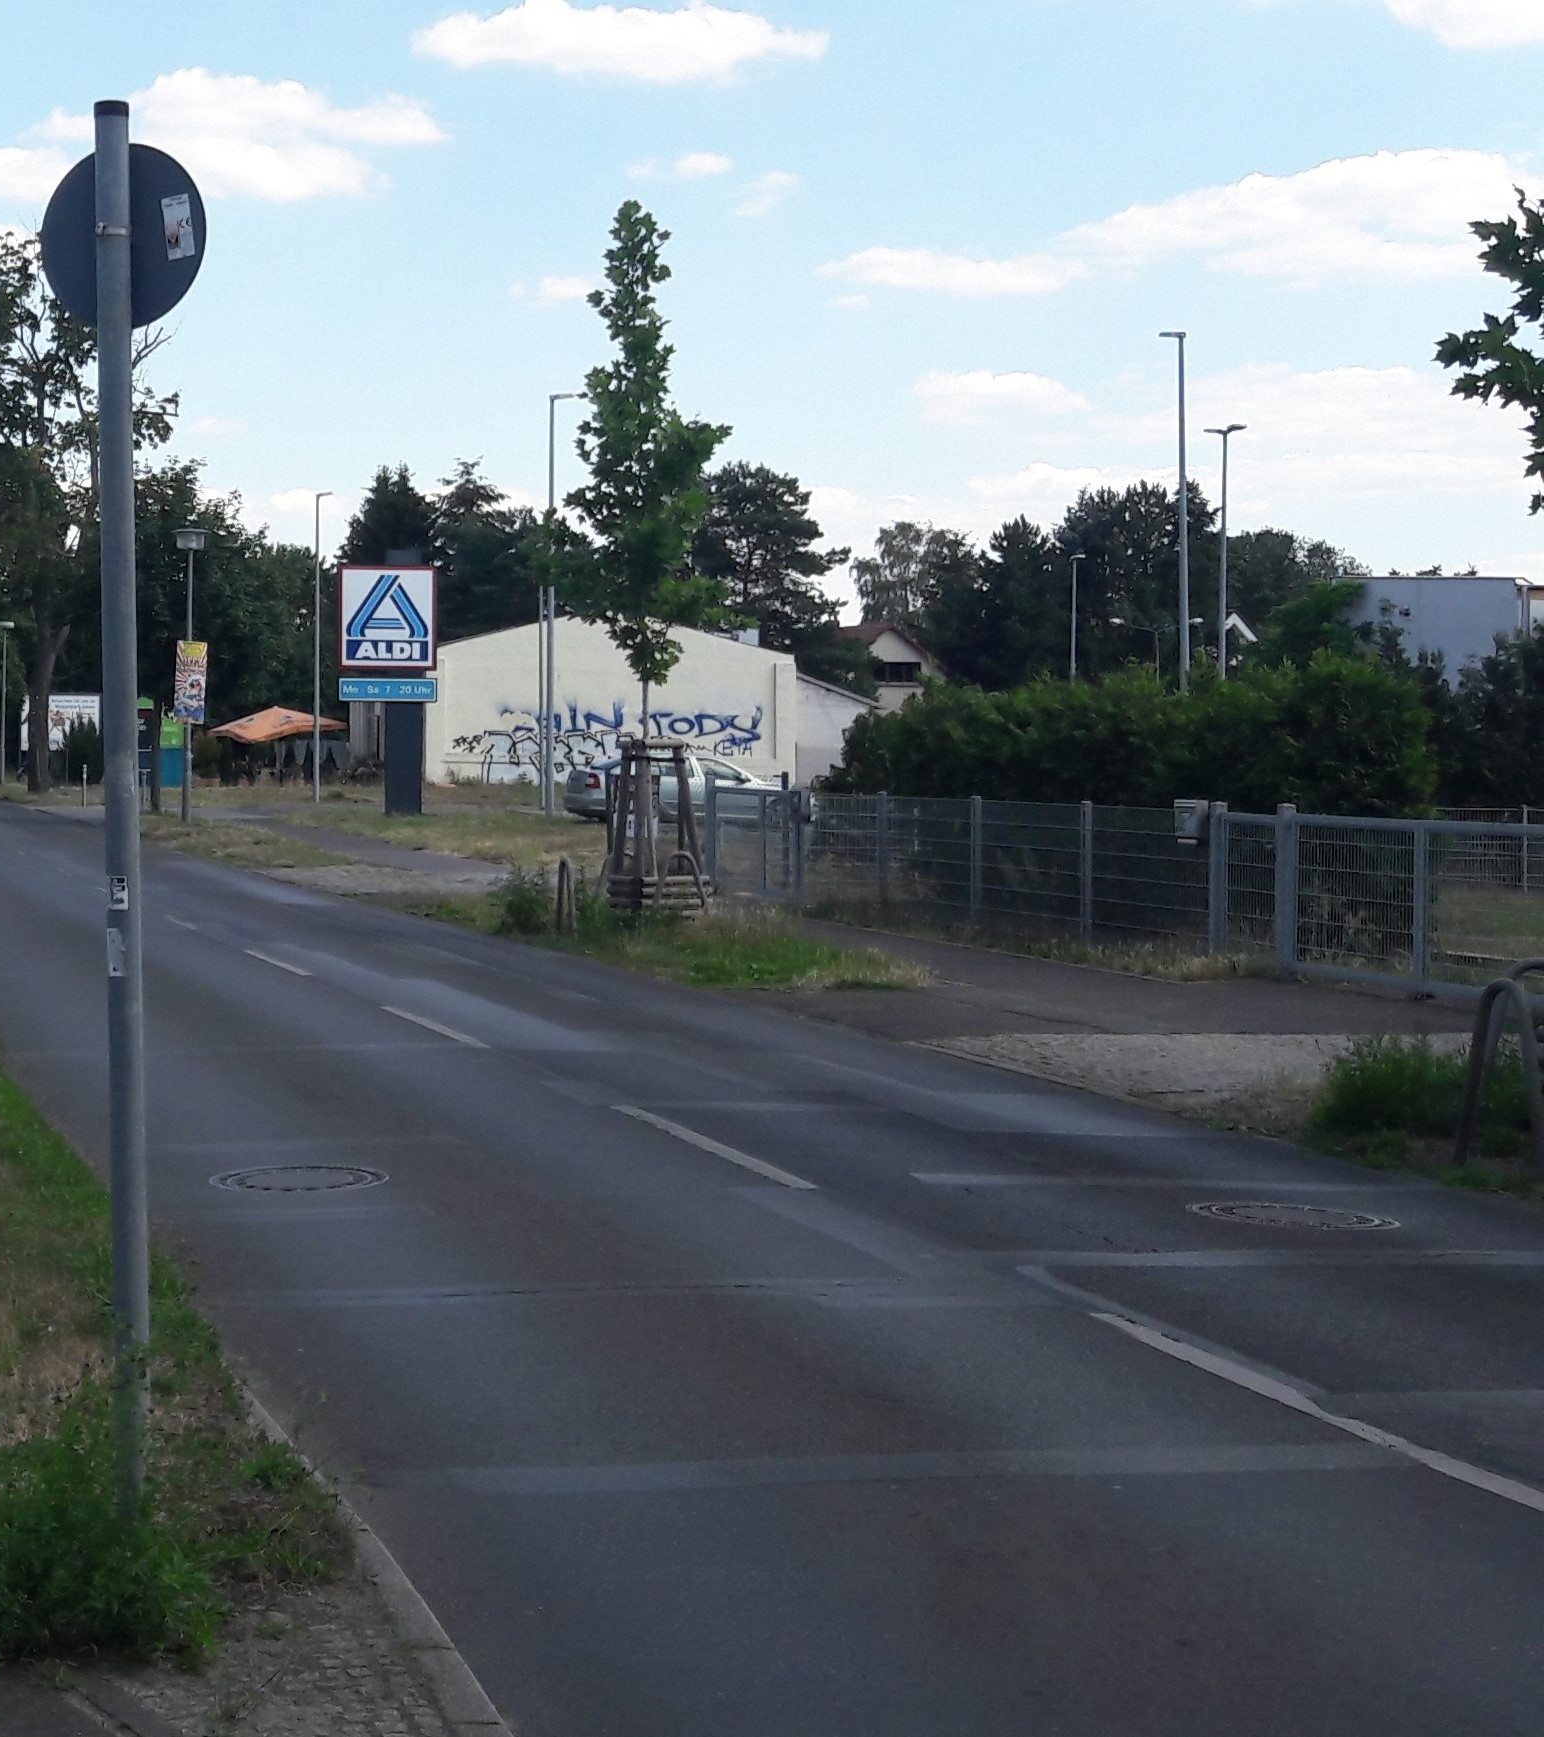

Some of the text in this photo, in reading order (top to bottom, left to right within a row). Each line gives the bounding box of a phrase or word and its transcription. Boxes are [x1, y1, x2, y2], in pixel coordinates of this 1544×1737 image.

[354, 641, 421, 660] ALDI
[342, 684, 359, 695] Mo
[367, 684, 379, 695] Sa
[414, 684, 433, 695] Uhr
